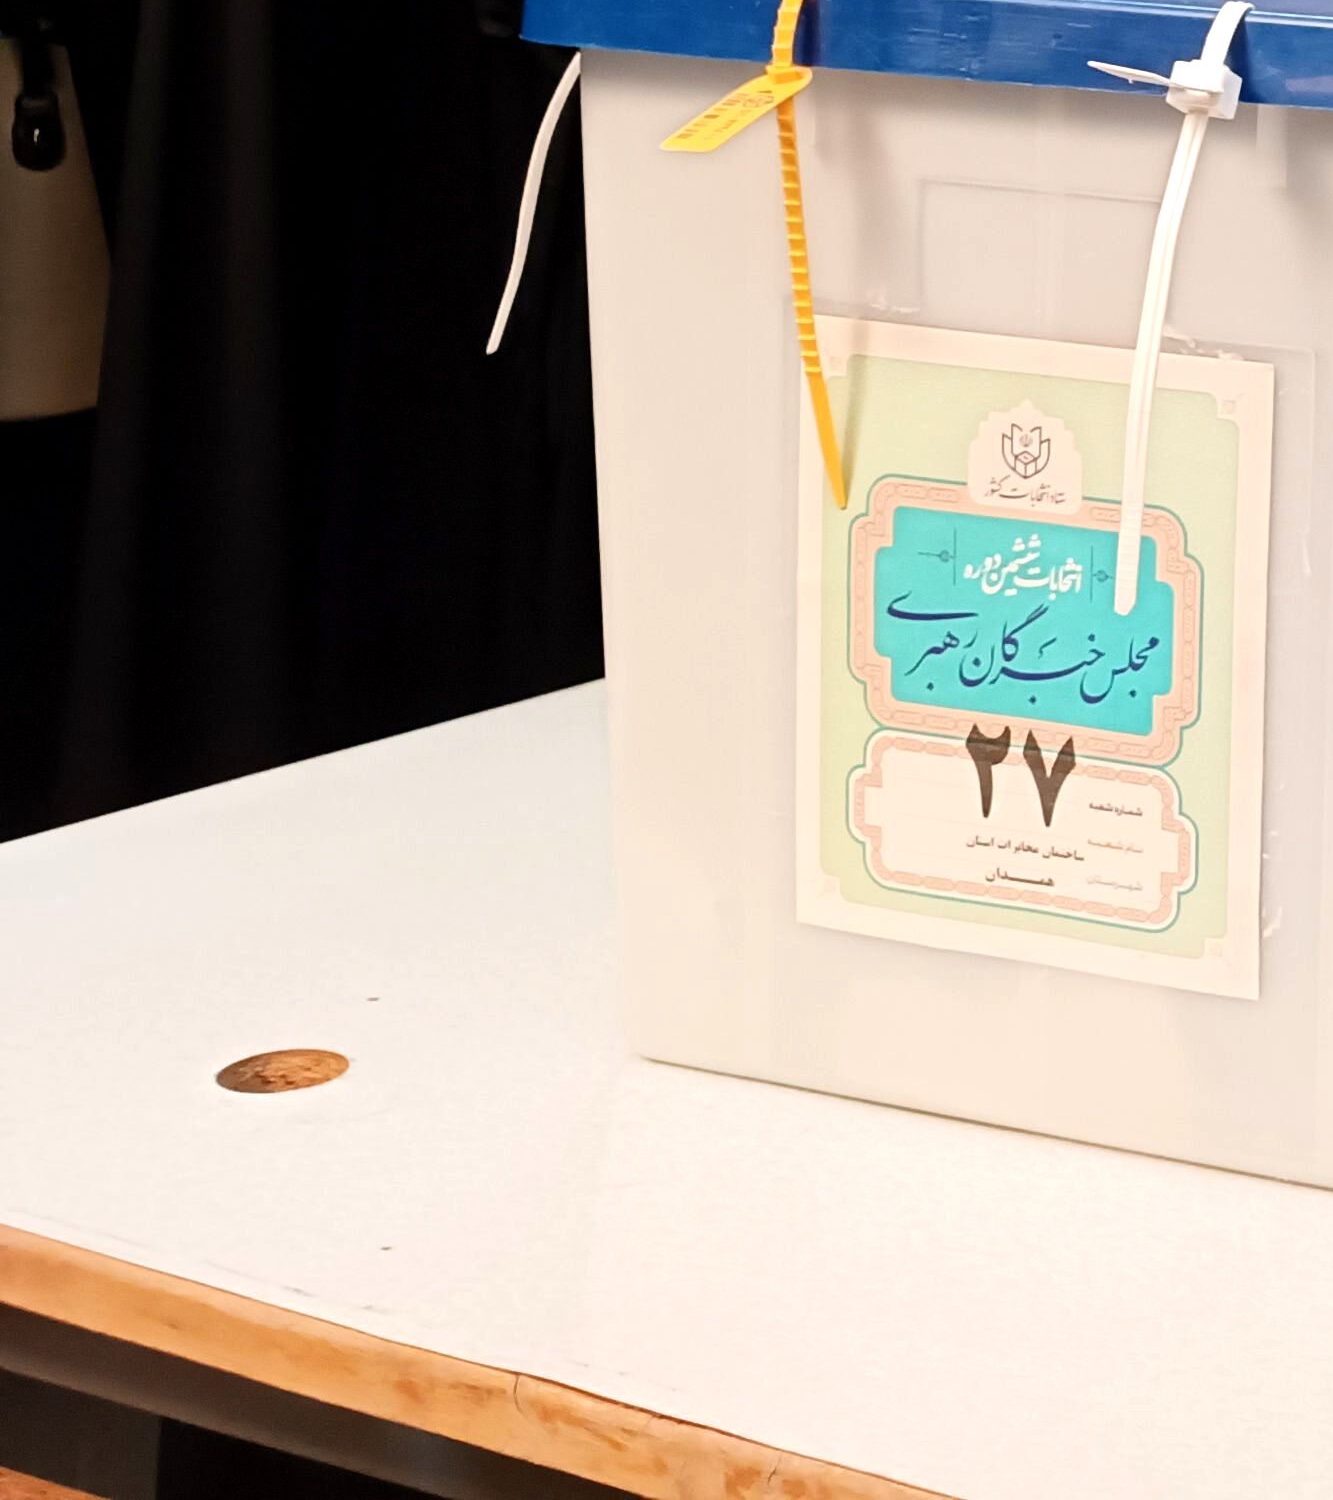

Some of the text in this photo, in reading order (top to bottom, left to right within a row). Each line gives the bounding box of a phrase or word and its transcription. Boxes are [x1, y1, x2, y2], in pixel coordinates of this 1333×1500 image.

[963, 533, 1083, 601] انتخابات ششمین دوره
[886, 590, 1160, 705] مجلس خبرگان رهبری
[965, 723, 1077, 828] ۲۷
[985, 867, 1055, 887] همدان
